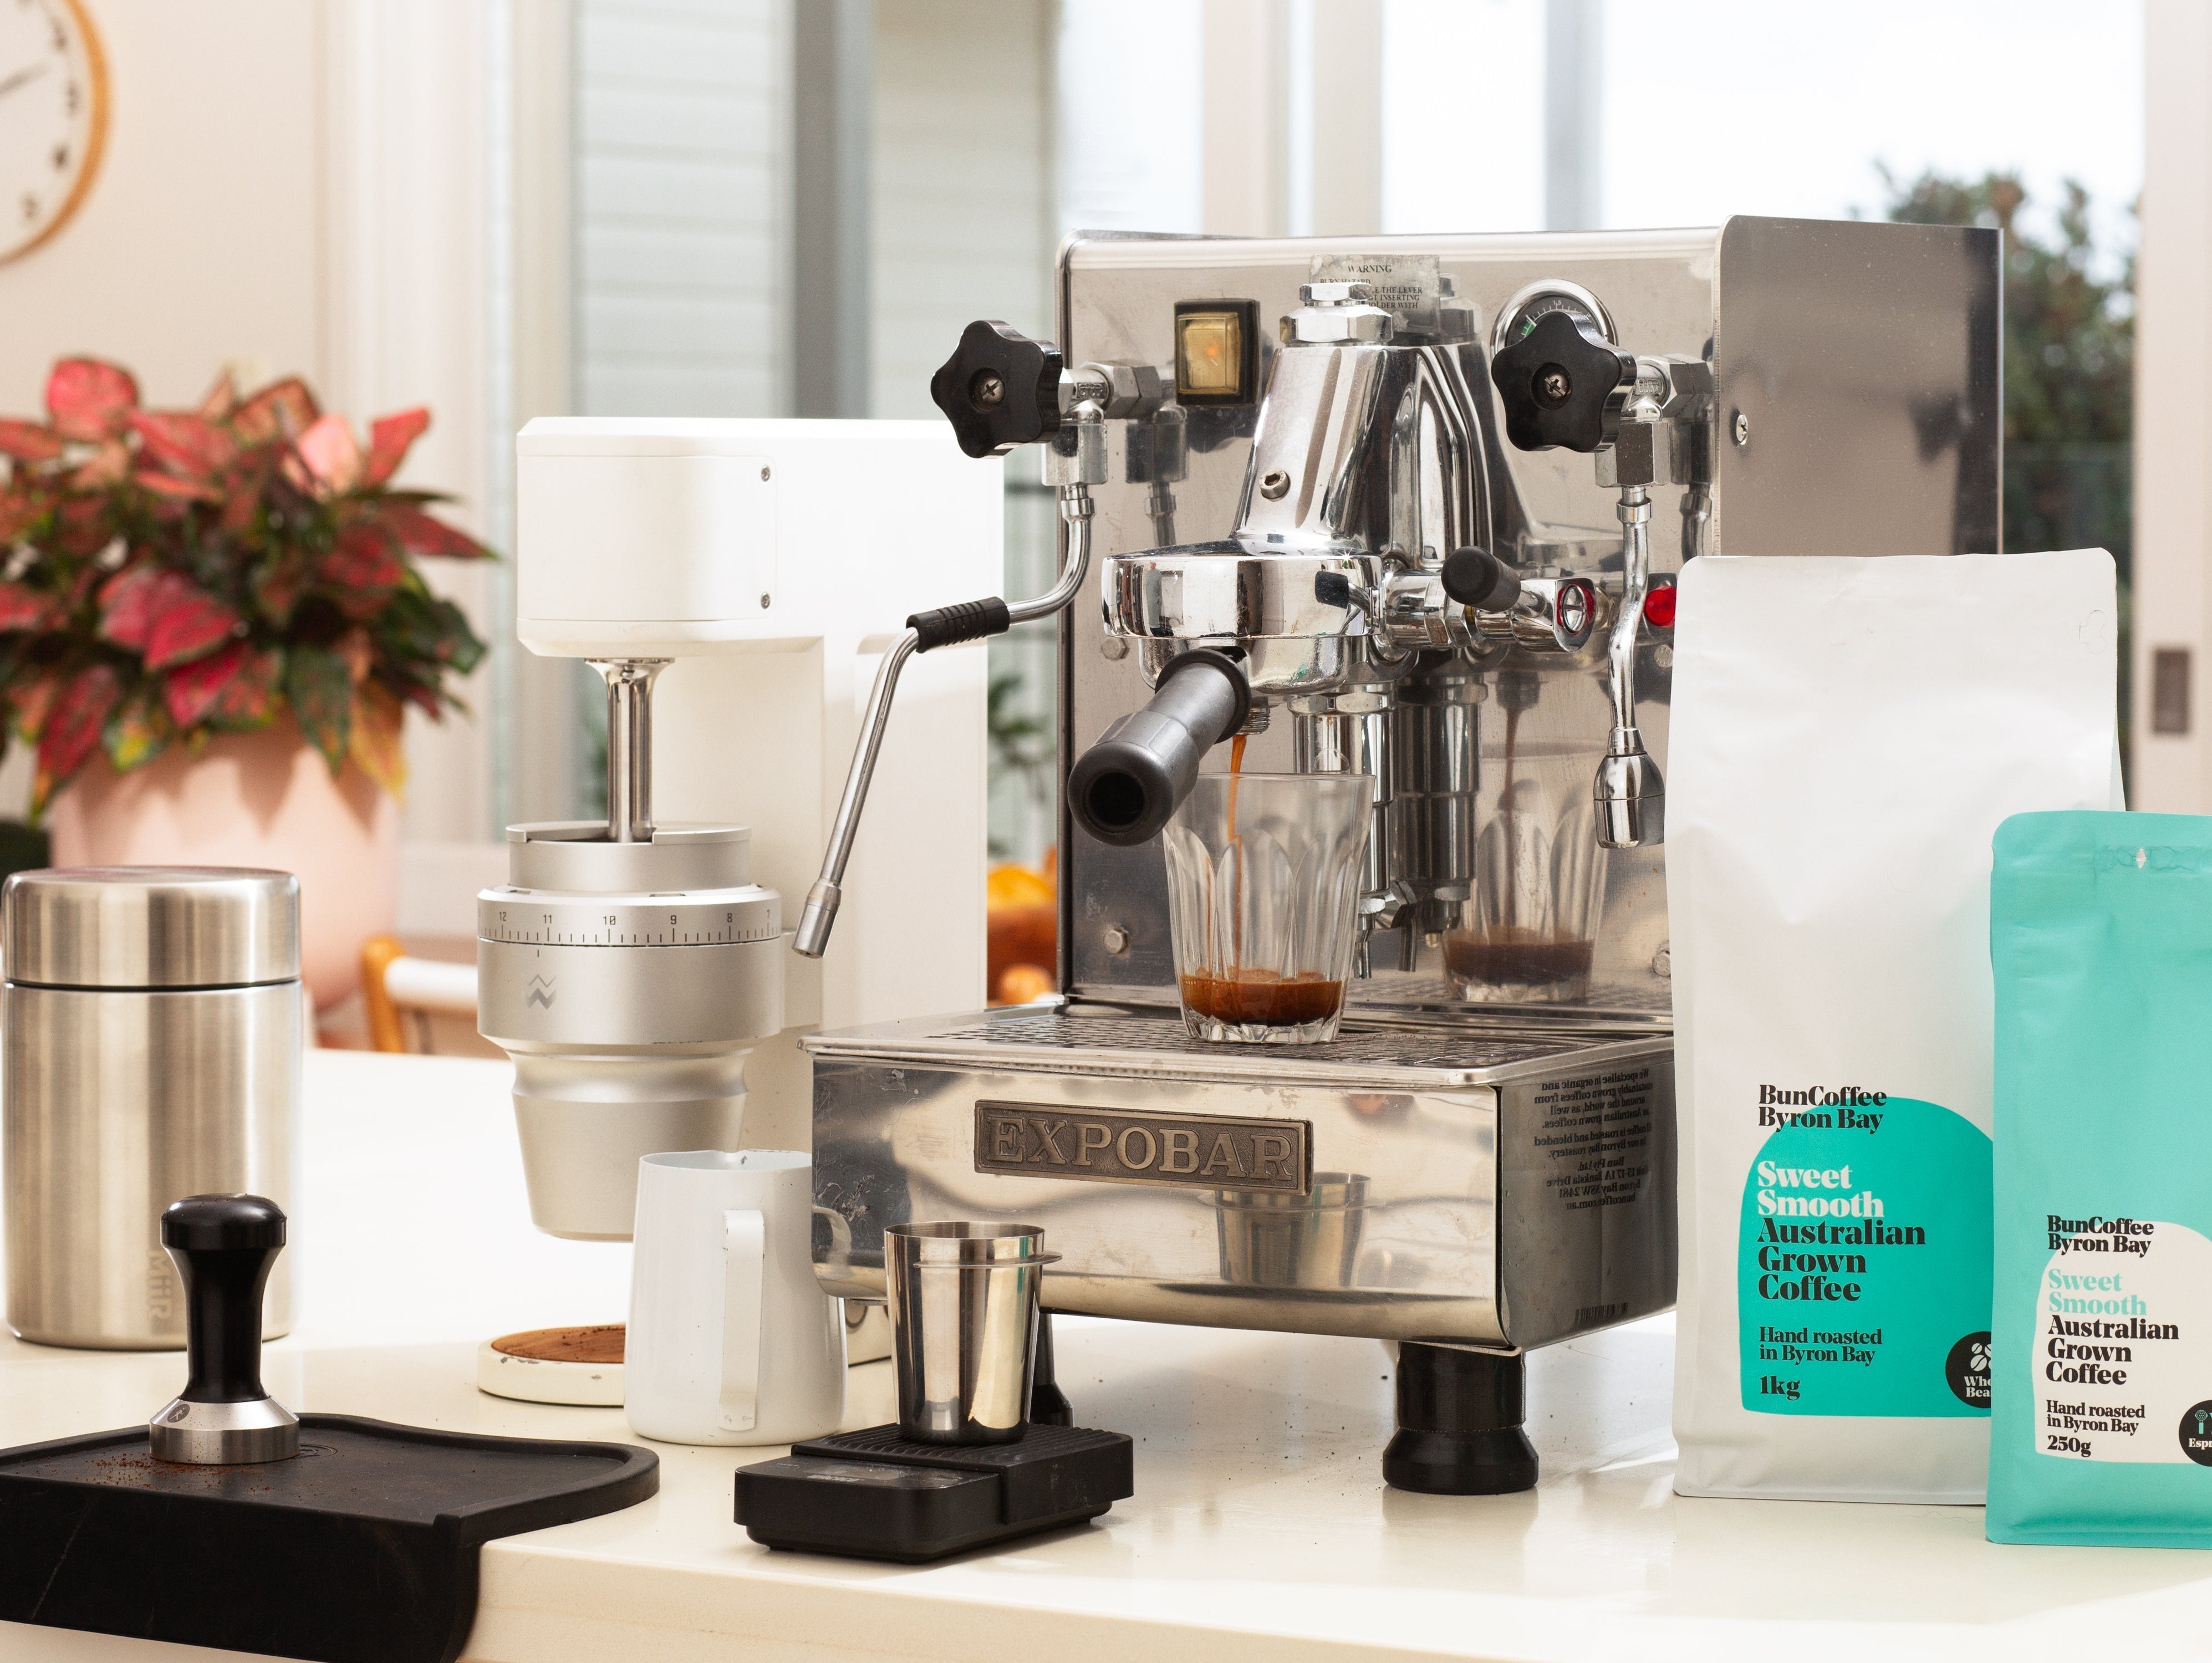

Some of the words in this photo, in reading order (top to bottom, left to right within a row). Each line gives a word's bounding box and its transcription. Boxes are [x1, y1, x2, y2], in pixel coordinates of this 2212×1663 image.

[499, 911, 507, 921] 12
[543, 914, 553, 924] 11
[603, 915, 616, 925] 10
[670, 915, 677, 925] 9
[727, 912, 733, 922] 8
[766, 909, 771, 918] 7
[1759, 1084, 1887, 1108] BunCoffee
[1759, 1107, 1832, 1132] Byron
[1837, 1108, 1883, 1134] Bay
[986, 1116, 1293, 1181] EXPOBAR
[1758, 1161, 1852, 1190] Sweet
[1758, 1190, 1884, 1218] Smooth
[1758, 1218, 1925, 1246] Australian
[2047, 1215, 2154, 1236] BunCoffee
[2048, 1234, 2109, 1256] Byron
[2113, 1235, 2150, 1258] Bay
[1758, 1247, 1867, 1273] Grown
[1759, 1274, 1861, 1302] Coffee
[2048, 1269, 2122, 1292] Sweet
[2048, 1292, 2147, 1315] Smooth
[1759, 1327, 1807, 1345] Hand
[1811, 1327, 1882, 1345] roasted
[2048, 1315, 2179, 1340] Australian
[1760, 1345, 1778, 1360] in
[1781, 1345, 1838, 1365] Byron
[1841, 1345, 1875, 1366] Bay
[2047, 1337, 2132, 1362] Grown
[2046, 1362, 2127, 1384] Coffee
[1760, 1375, 1800, 1400] 1kg
[1966, 1387, 1991, 1397] Bea
[2046, 1400, 2085, 1417] Hand
[2088, 1402, 2145, 1420] roasted
[2047, 1415, 2062, 1429] in
[2064, 1416, 2108, 1434] Byron
[2111, 1418, 2139, 1436] Bay
[2047, 1435, 2091, 1457] 250g
